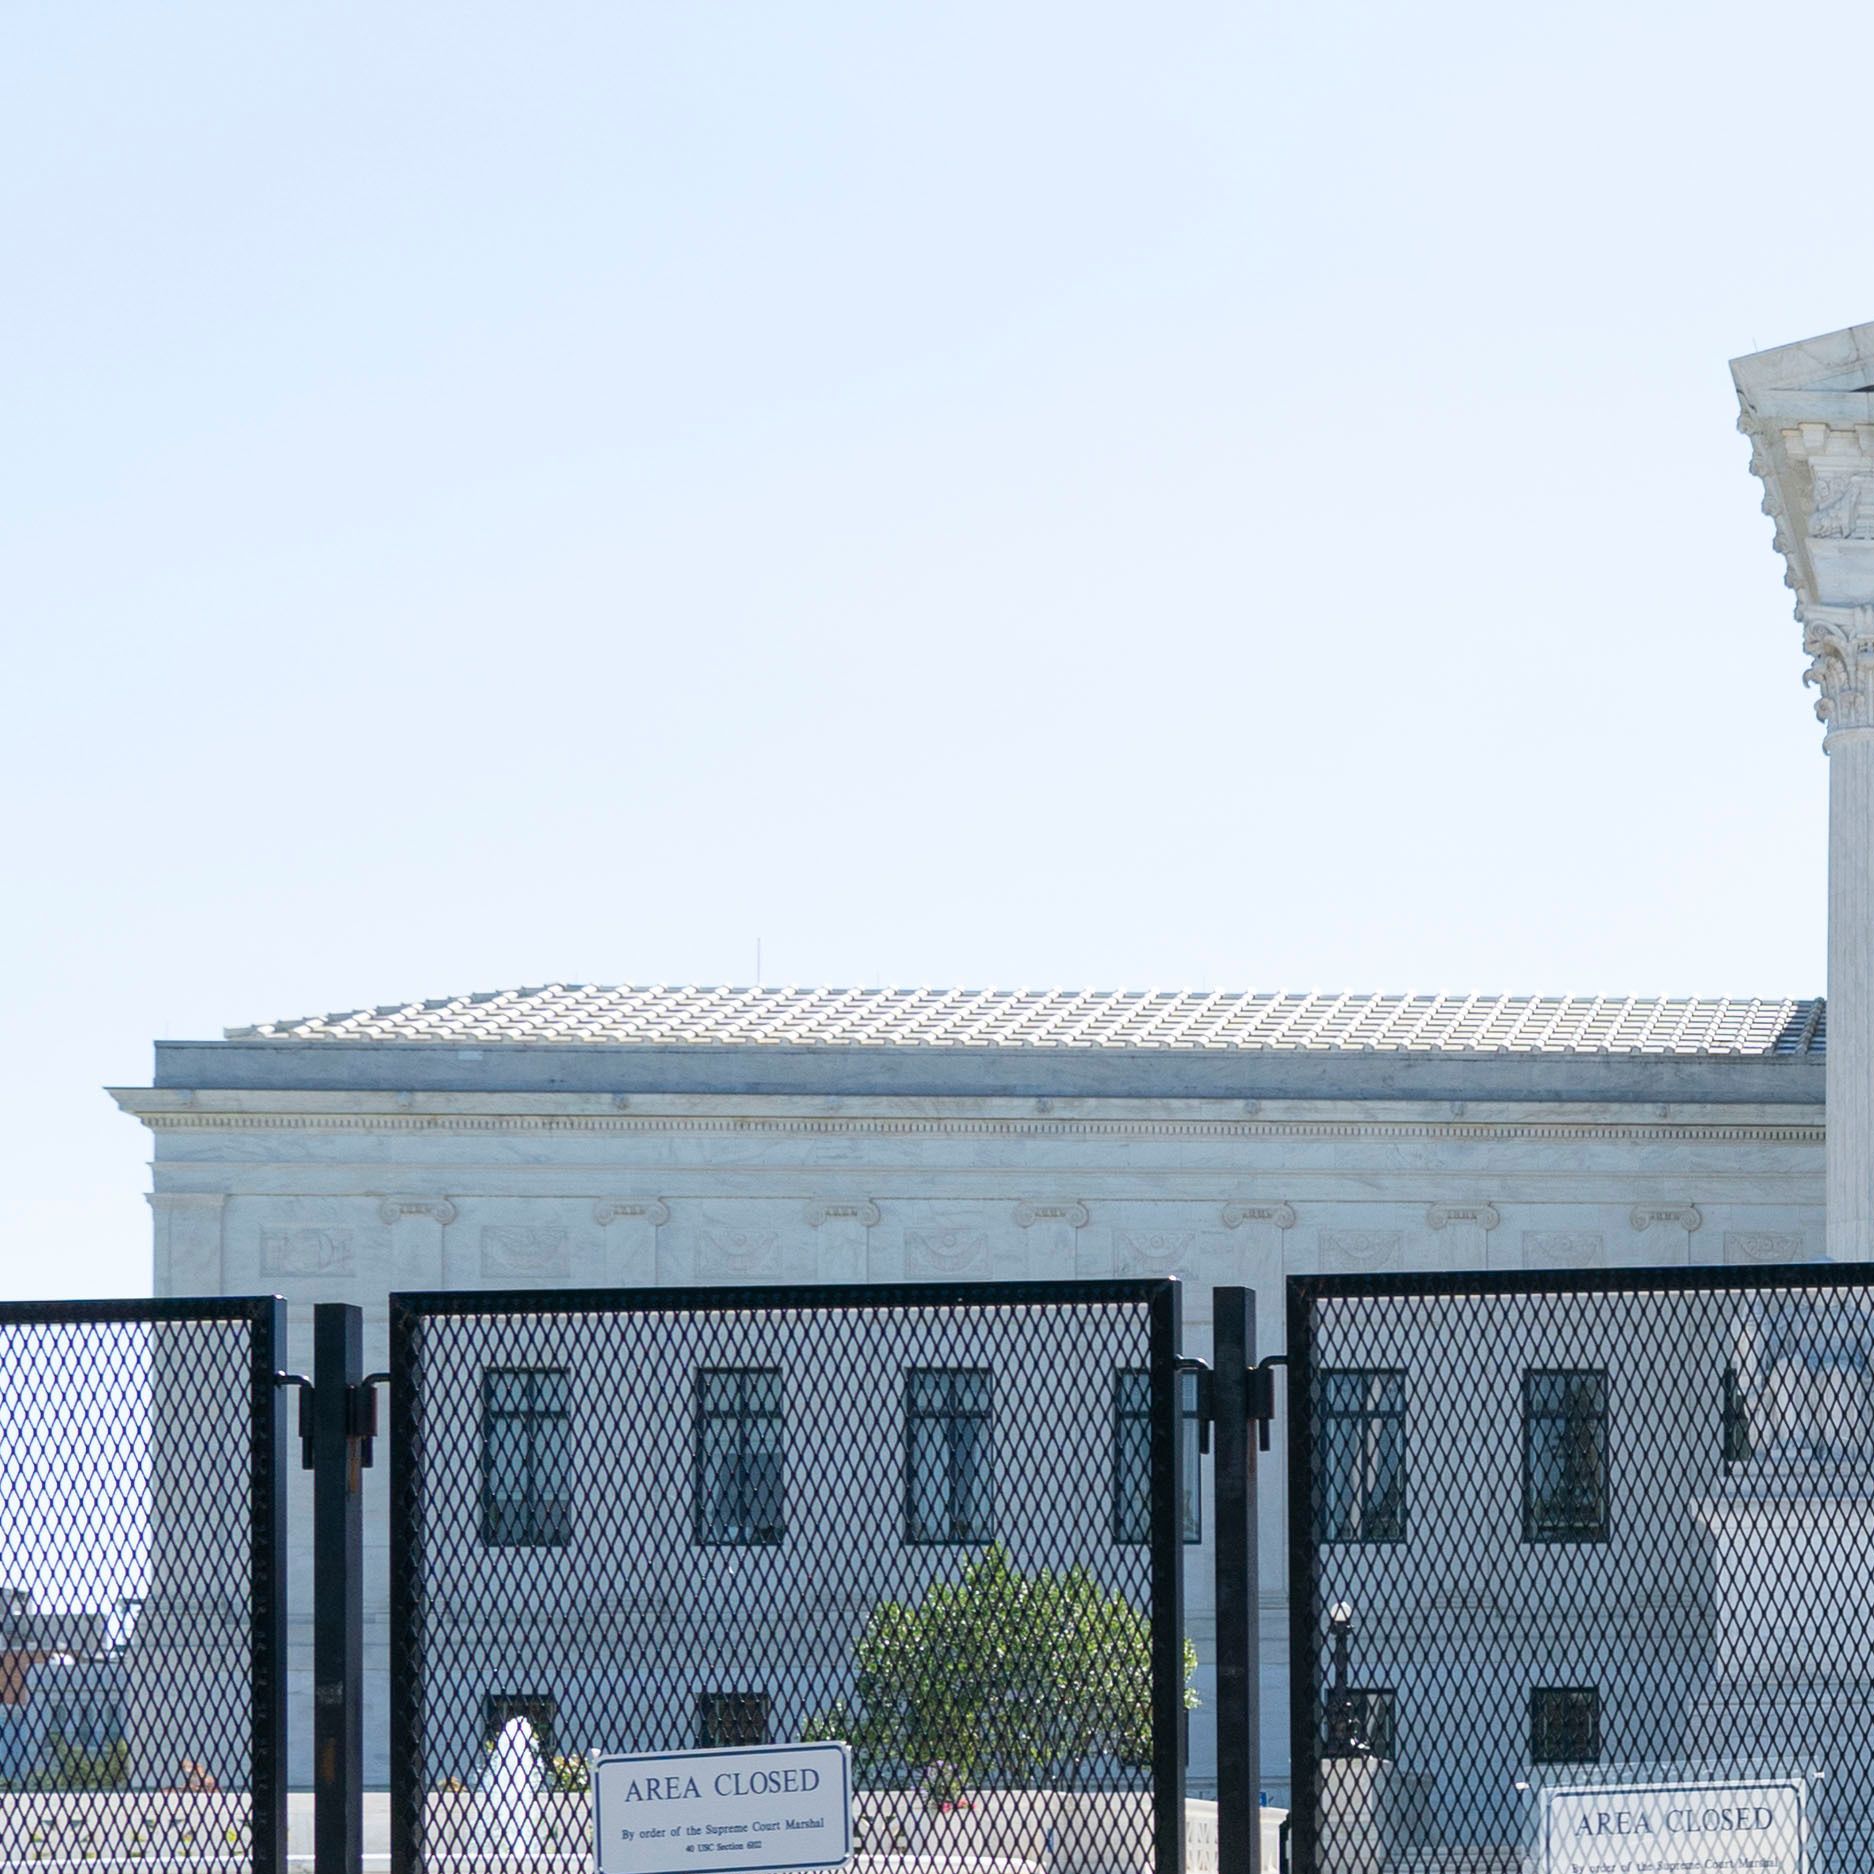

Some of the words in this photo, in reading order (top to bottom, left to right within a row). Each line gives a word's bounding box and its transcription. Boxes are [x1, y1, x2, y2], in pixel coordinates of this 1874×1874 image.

[624, 1776, 702, 1802] AREA
[714, 1768, 820, 1797] CLOSED
[640, 1828, 665, 1839] order
[686, 1826, 702, 1836] the
[705, 1824, 748, 1836] Supreme
[752, 1821, 780, 1832] Court
[785, 1818, 825, 1830] Marshal
[1575, 1811, 1653, 1836] AREA
[1666, 1807, 1773, 1833] CLOSED
[716, 1842, 744, 1851] Section
